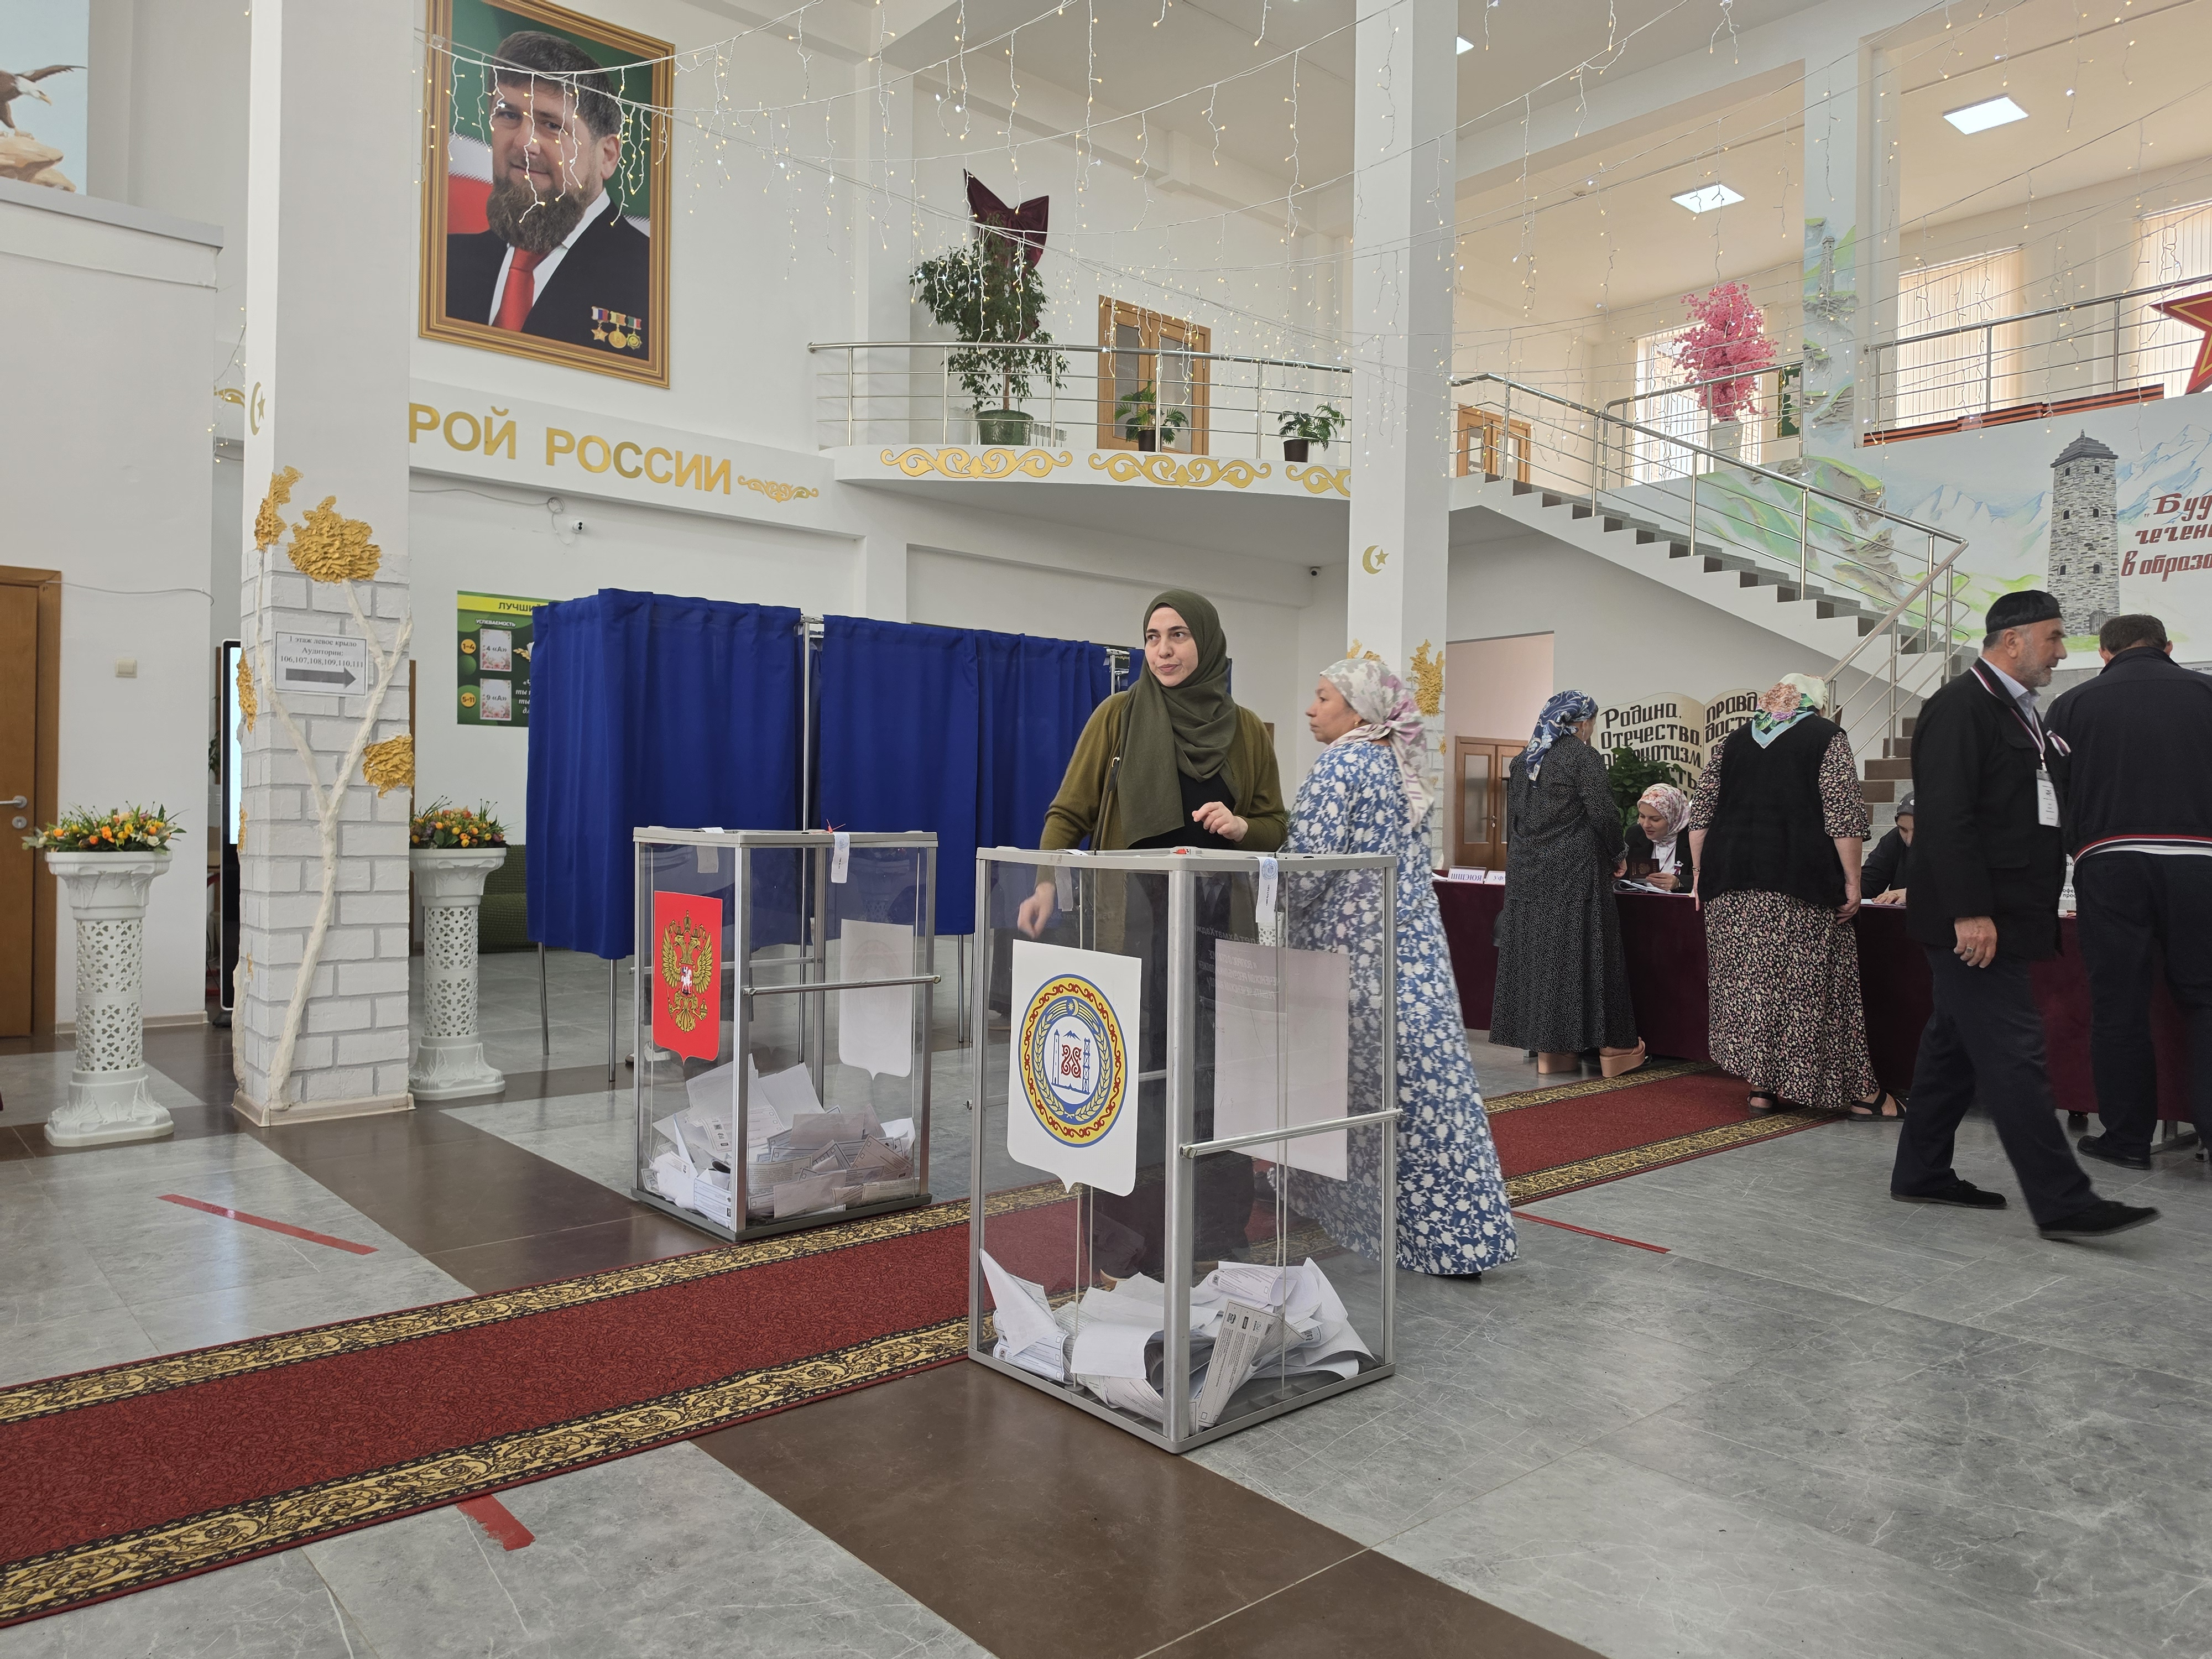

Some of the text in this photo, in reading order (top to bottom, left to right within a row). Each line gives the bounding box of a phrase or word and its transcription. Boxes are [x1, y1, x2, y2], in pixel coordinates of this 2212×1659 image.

[409, 403, 731, 495] РОЙ РОССИИ
[499, 602, 541, 612] ЛУЧШИ
[476, 619, 516, 627] УСПЕВАЕМОСТЬ
[301, 647, 343, 657] Аудитории:
[280, 655, 363, 668] 106,107,108,109,110,111
[1707, 692, 1760, 724] правд
